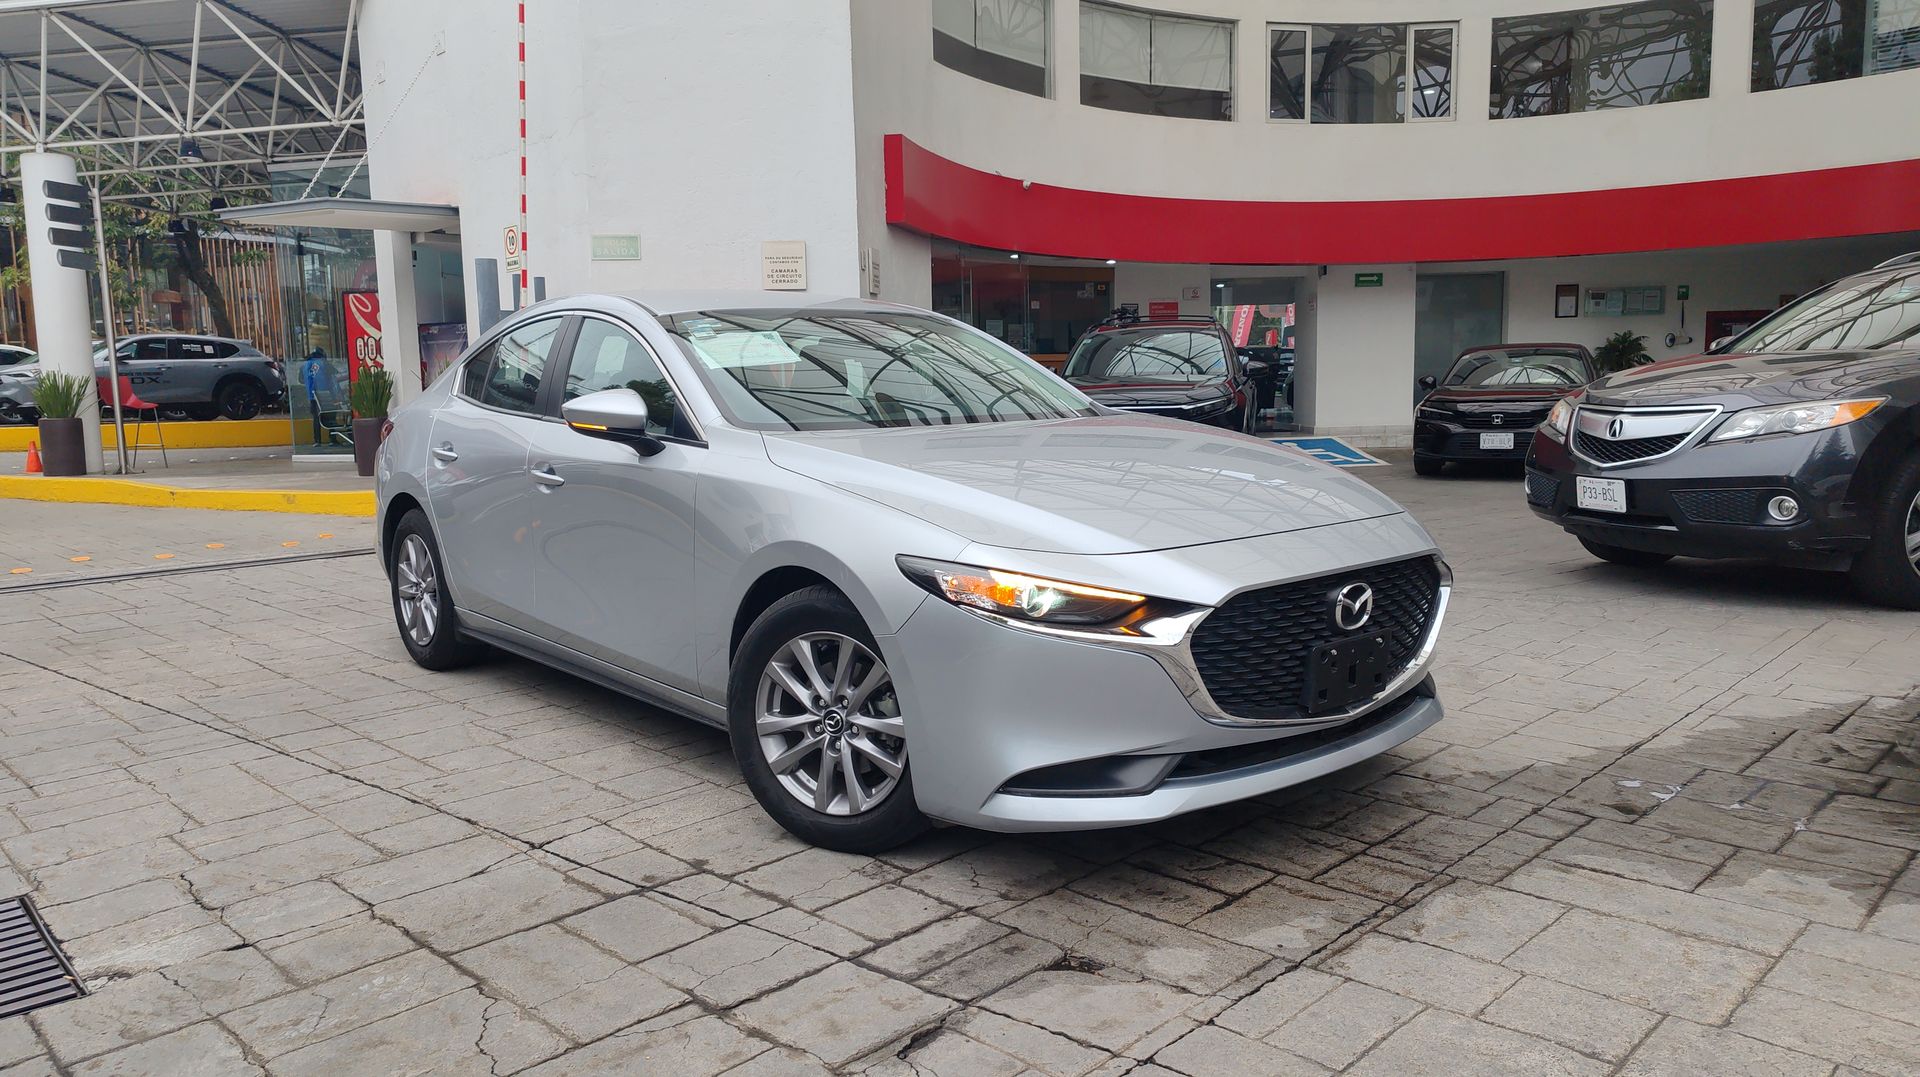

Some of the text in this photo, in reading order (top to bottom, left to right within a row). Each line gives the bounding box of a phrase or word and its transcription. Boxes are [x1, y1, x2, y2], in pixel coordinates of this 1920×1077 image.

[508, 235, 515, 246] 10
[597, 248, 635, 256] SALIDA
[1582, 485, 1618, 502] P33-BSL
